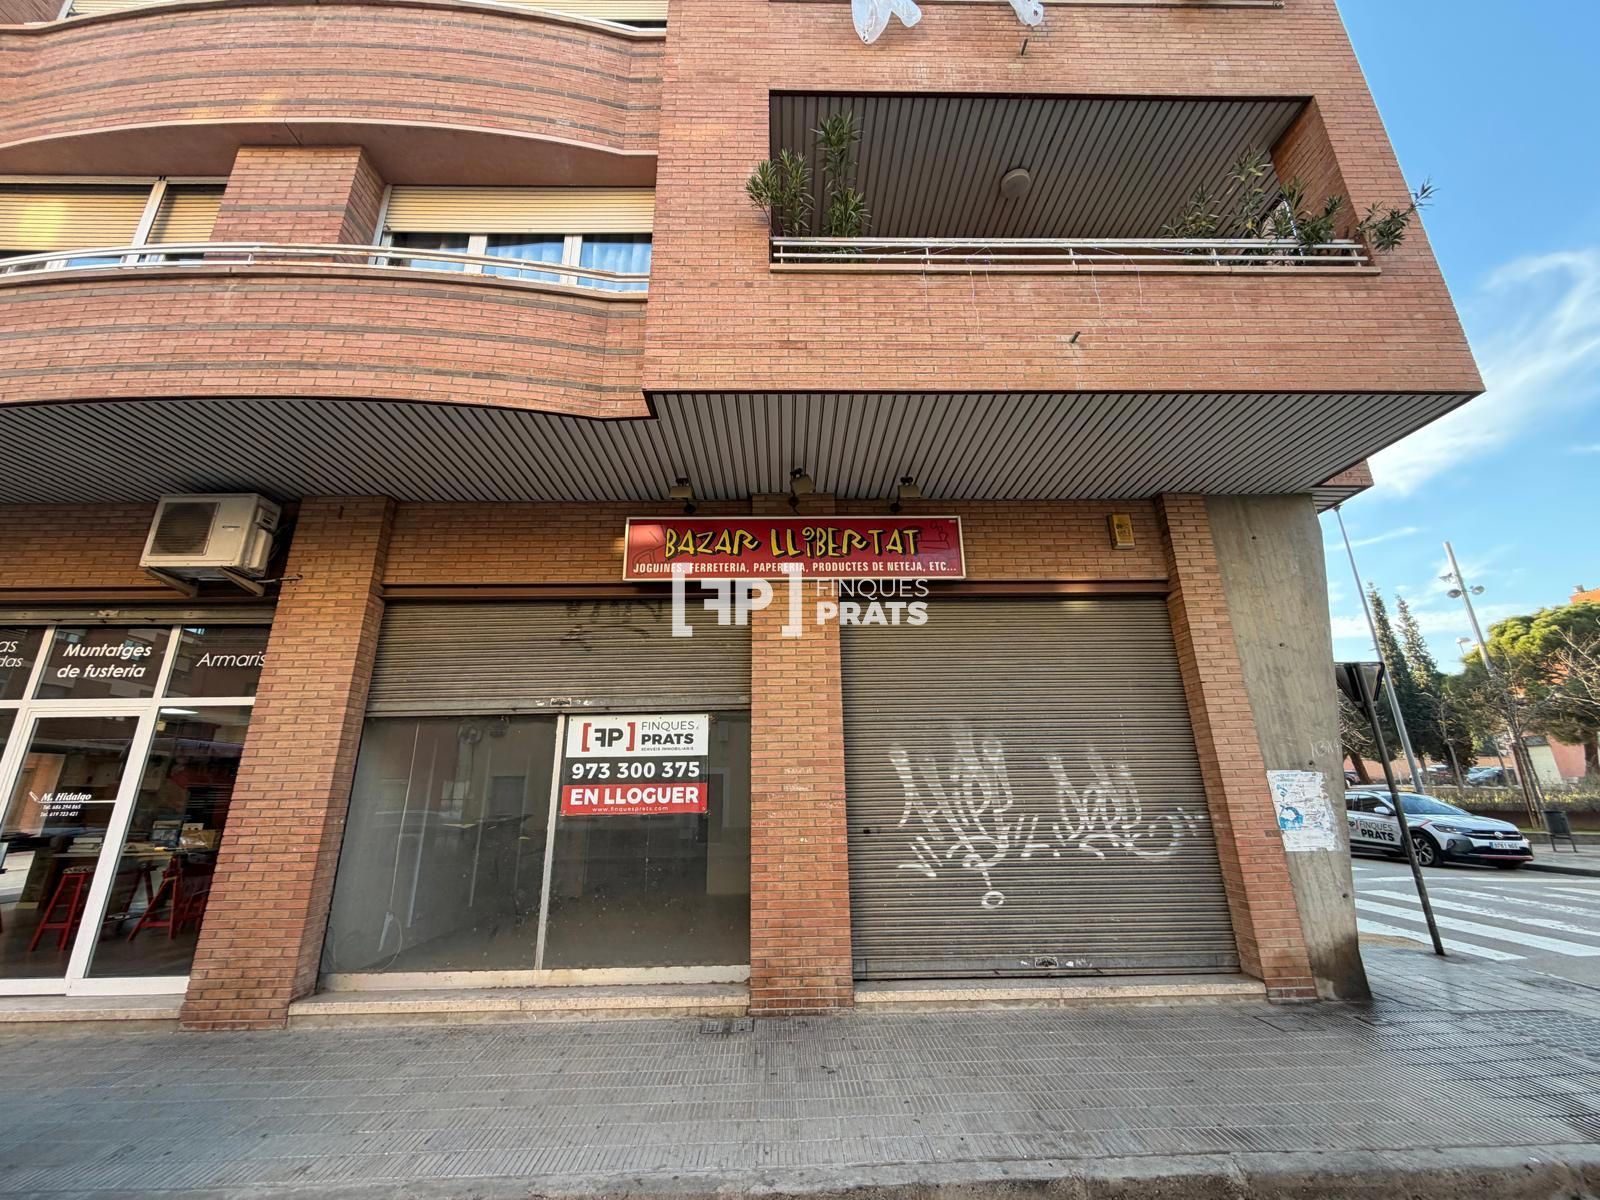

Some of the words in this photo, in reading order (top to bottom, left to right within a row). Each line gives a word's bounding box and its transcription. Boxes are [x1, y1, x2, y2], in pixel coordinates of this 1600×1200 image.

[665, 528, 758, 558] BAZAR
[812, 561, 869, 572] PRODUCTES
[872, 561, 884, 572] DE
[887, 561, 926, 573] NETEJA,
[63, 643, 152, 660] Muntatges
[57, 664, 79, 679] de
[83, 664, 146, 679] fusteria
[641, 720, 695, 732] FINQUES
[641, 733, 694, 745] PRATS
[571, 763, 610, 779] 973
[616, 762, 656, 779] 300
[661, 761, 700, 778] 375
[570, 788, 599, 806] EN
[604, 786, 699, 805] LLOGUER
[1360, 820, 1393, 832] FINQUES
[1361, 829, 1395, 842] PRATS
